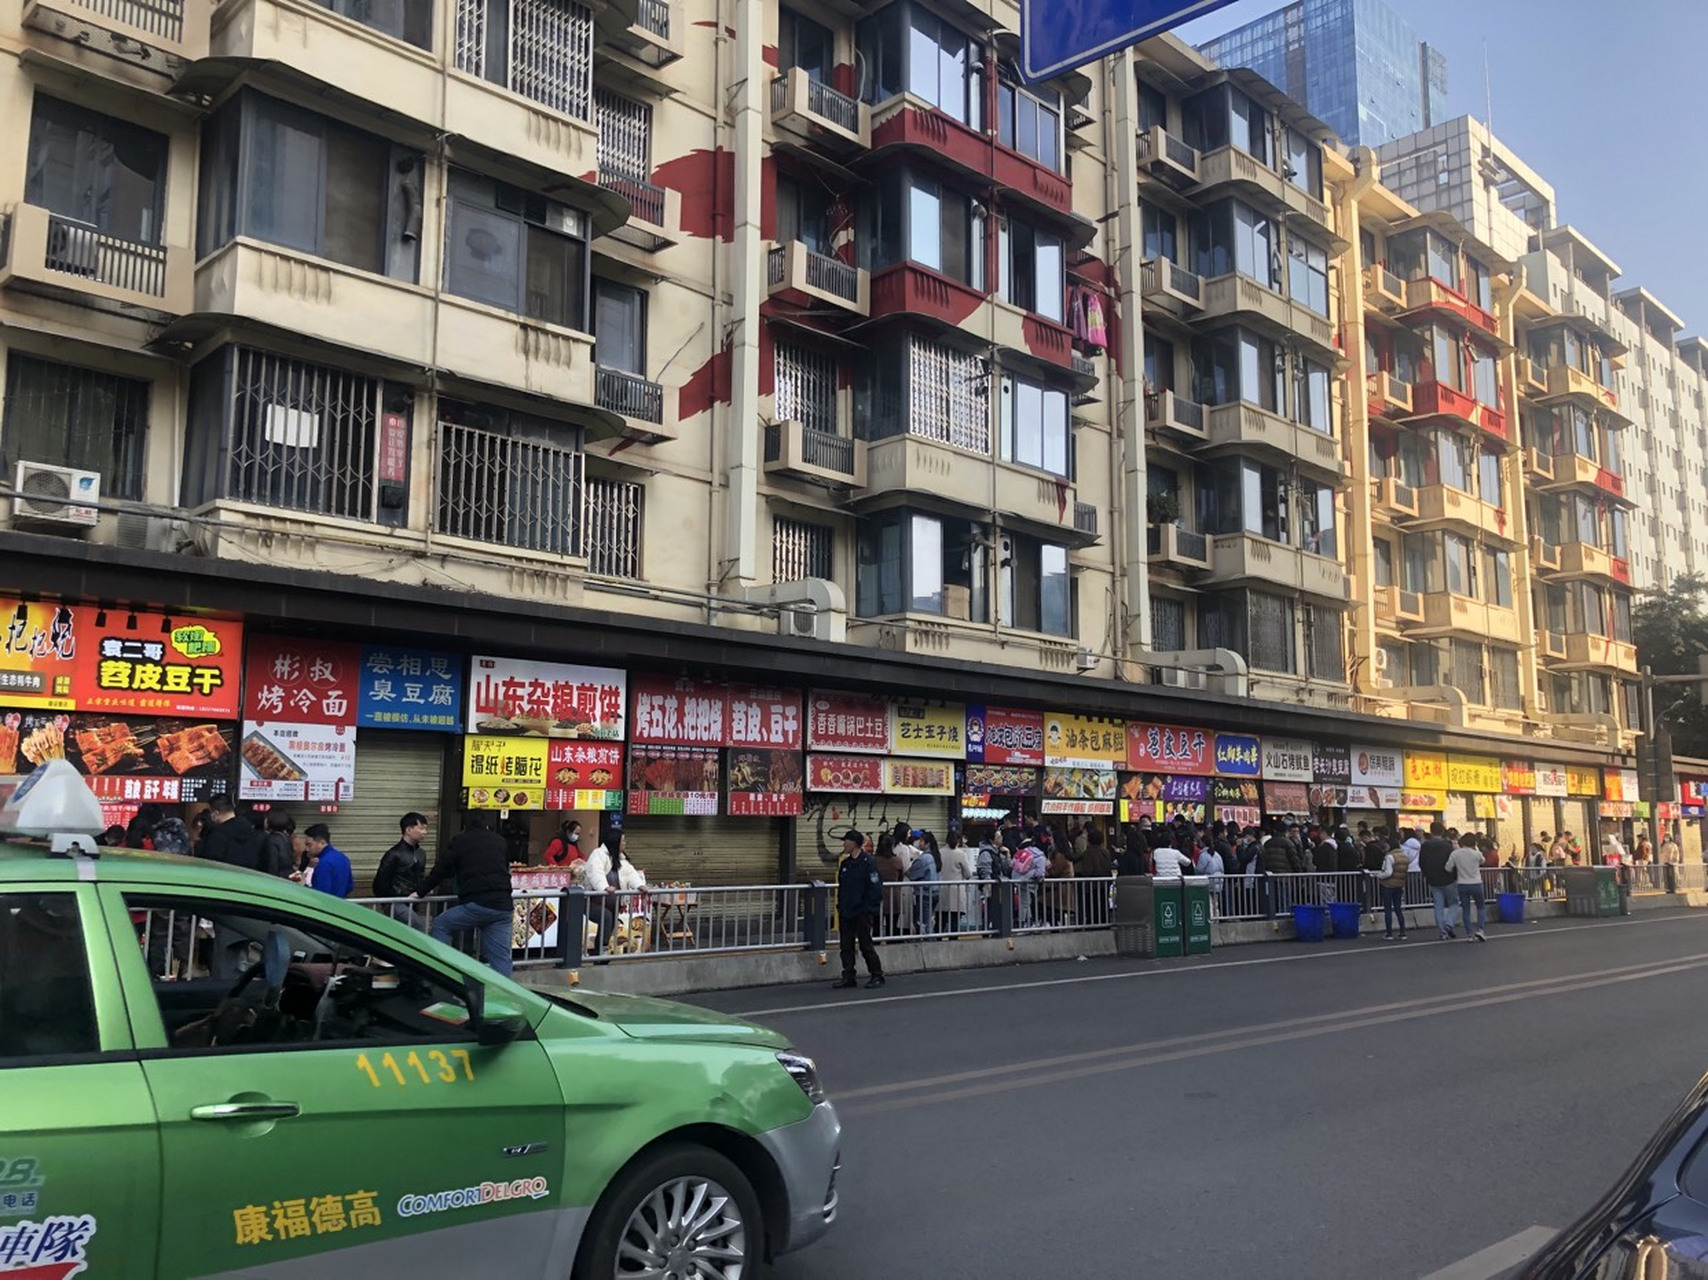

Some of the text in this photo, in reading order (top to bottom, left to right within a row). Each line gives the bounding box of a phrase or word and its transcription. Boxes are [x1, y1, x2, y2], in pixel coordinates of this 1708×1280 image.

[102, 639, 163, 660] 袁二哥
[100, 661, 222, 694] 苕皮豆干
[273, 653, 337, 683] 彬叔
[257, 685, 348, 717] 烤冷面
[369, 680, 455, 706] 臭豆腐
[475, 674, 620, 725] 山东杂粮煎饼
[551, 746, 620, 764] 山东杂粮煎饼
[356, 1049, 475, 1087] 11137
[233, 1190, 382, 1246] 康福德高
[0, 1219, 91, 1264] 車隊
